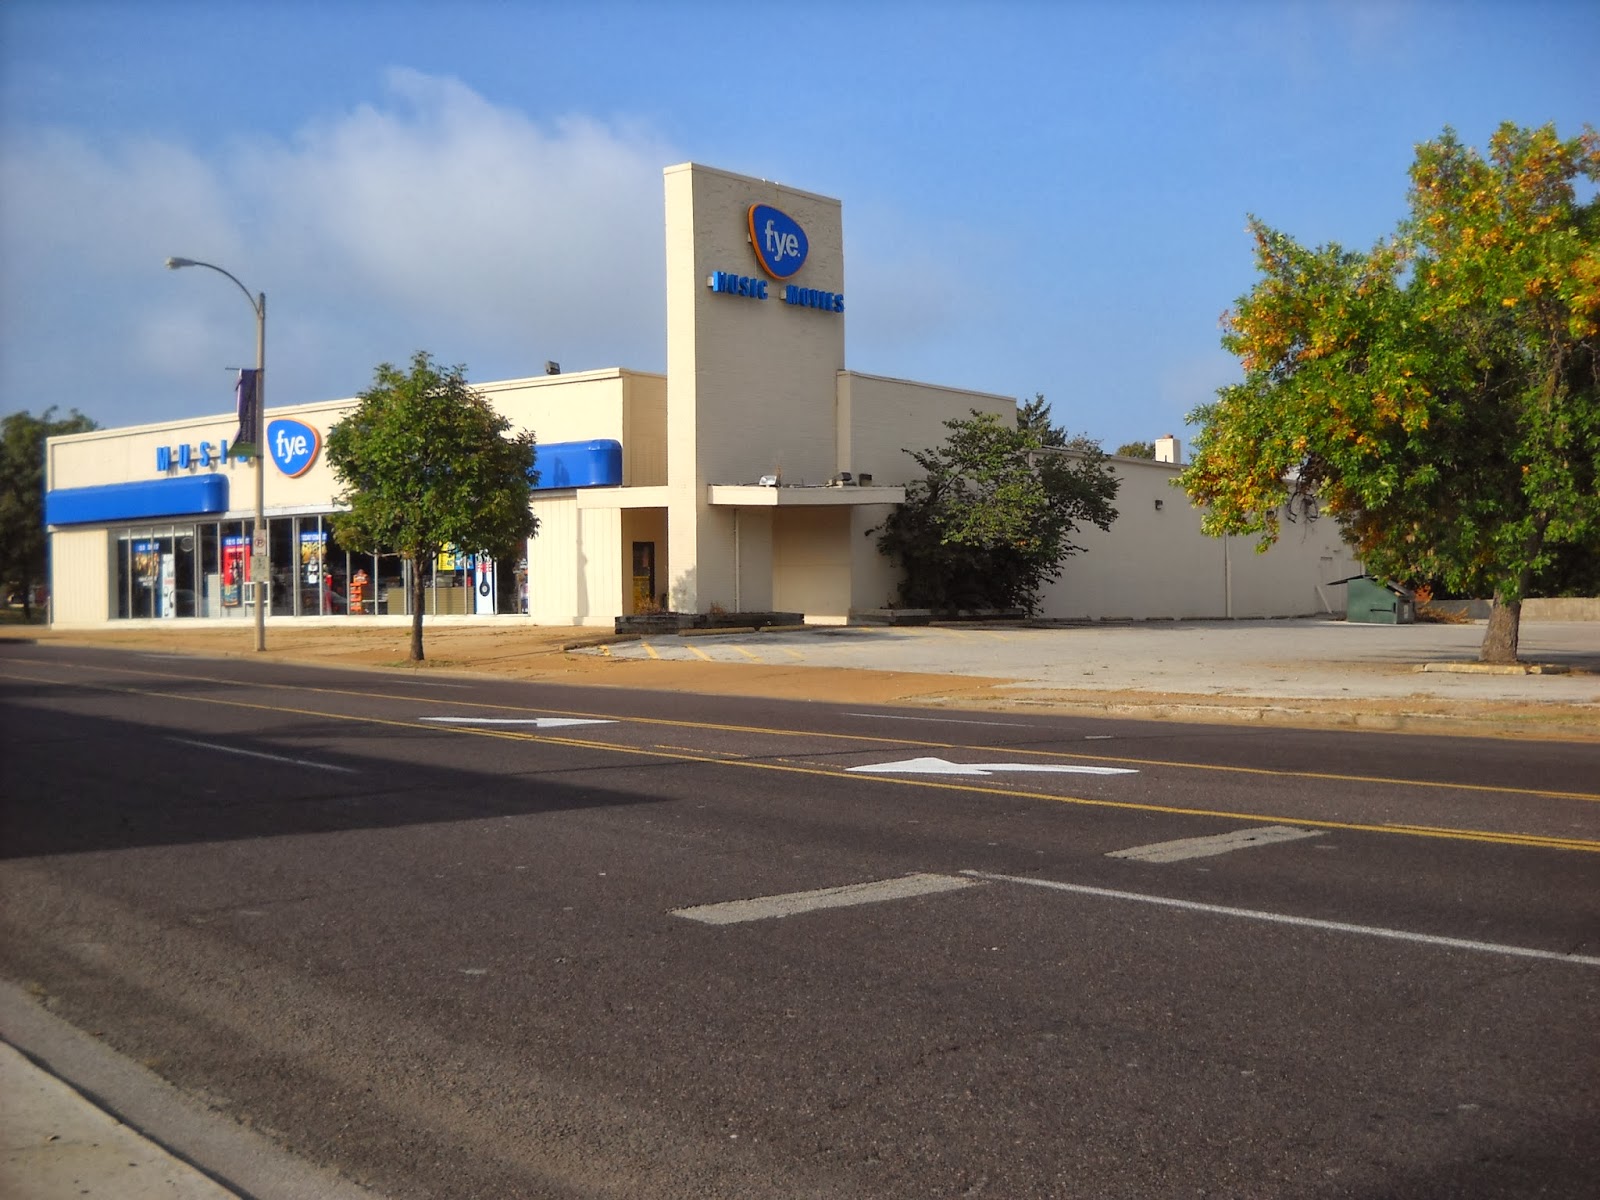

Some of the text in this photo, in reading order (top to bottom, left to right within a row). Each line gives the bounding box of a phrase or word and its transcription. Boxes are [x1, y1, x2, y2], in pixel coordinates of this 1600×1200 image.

[765, 219, 801, 262] f.y.e.
[712, 271, 845, 313] MUSIC MOVIES
[156, 439, 249, 472] MUSI
[276, 429, 308, 464] f.y.e.
